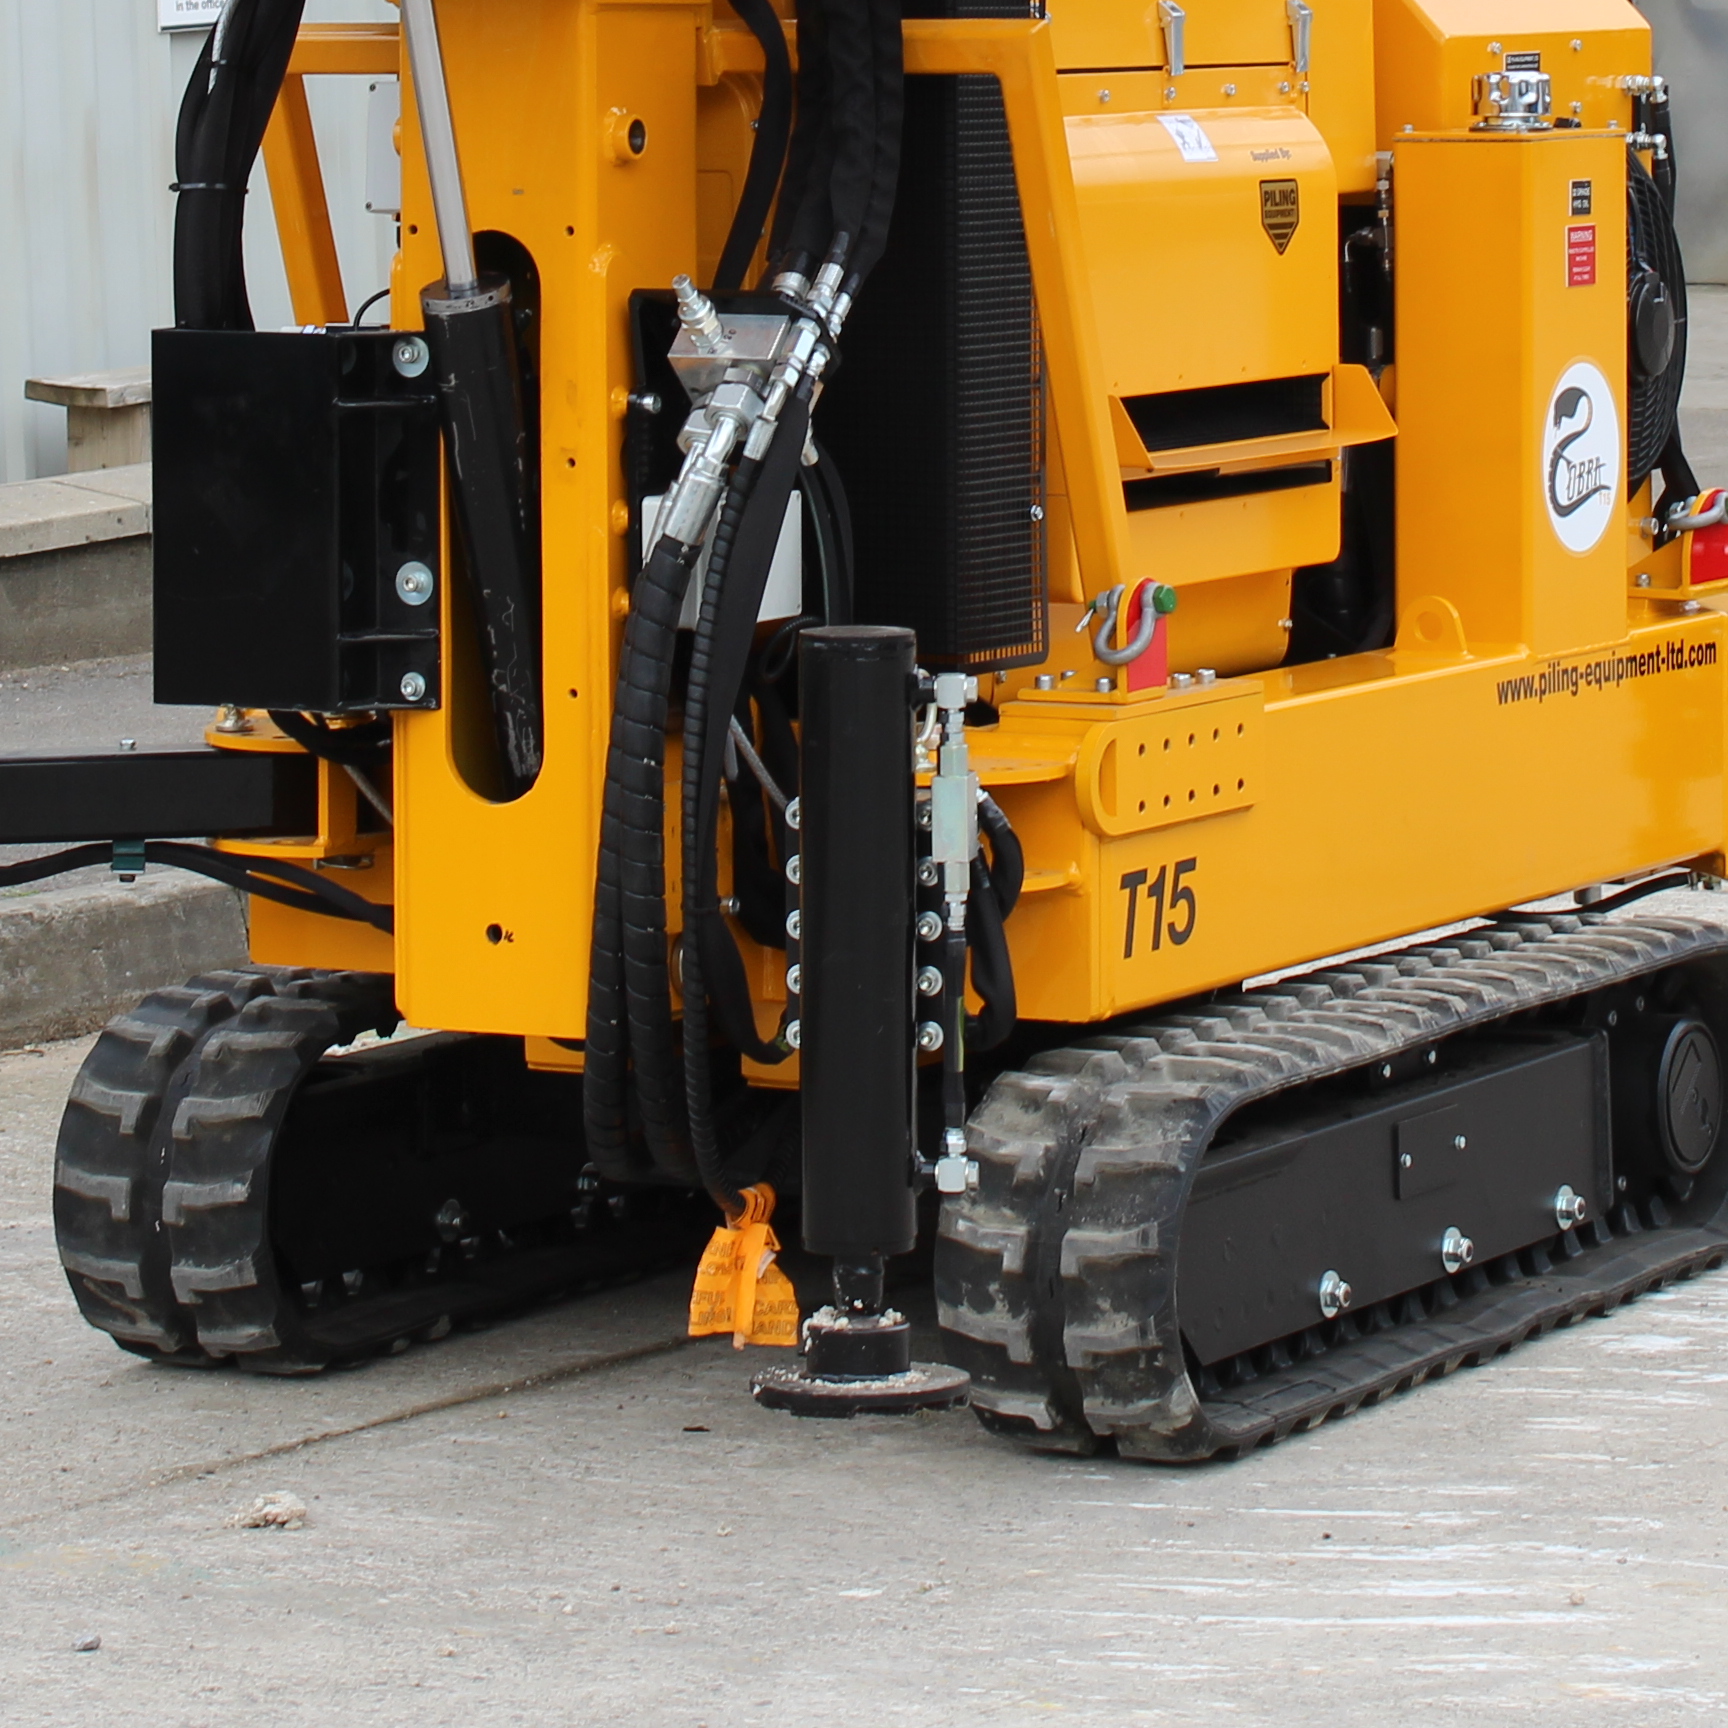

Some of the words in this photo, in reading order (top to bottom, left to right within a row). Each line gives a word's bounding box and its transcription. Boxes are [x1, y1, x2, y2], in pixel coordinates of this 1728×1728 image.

[175, 0, 184, 11] in
[1250, 148, 1280, 163] Supplied
[1263, 188, 1296, 207] PILING
[1264, 208, 1295, 219] EQUIPMENT
[1598, 491, 1612, 507] T15
[1496, 638, 1717, 705] www.piling-equipment-ltd.com
[1119, 856, 1198, 960] T15
